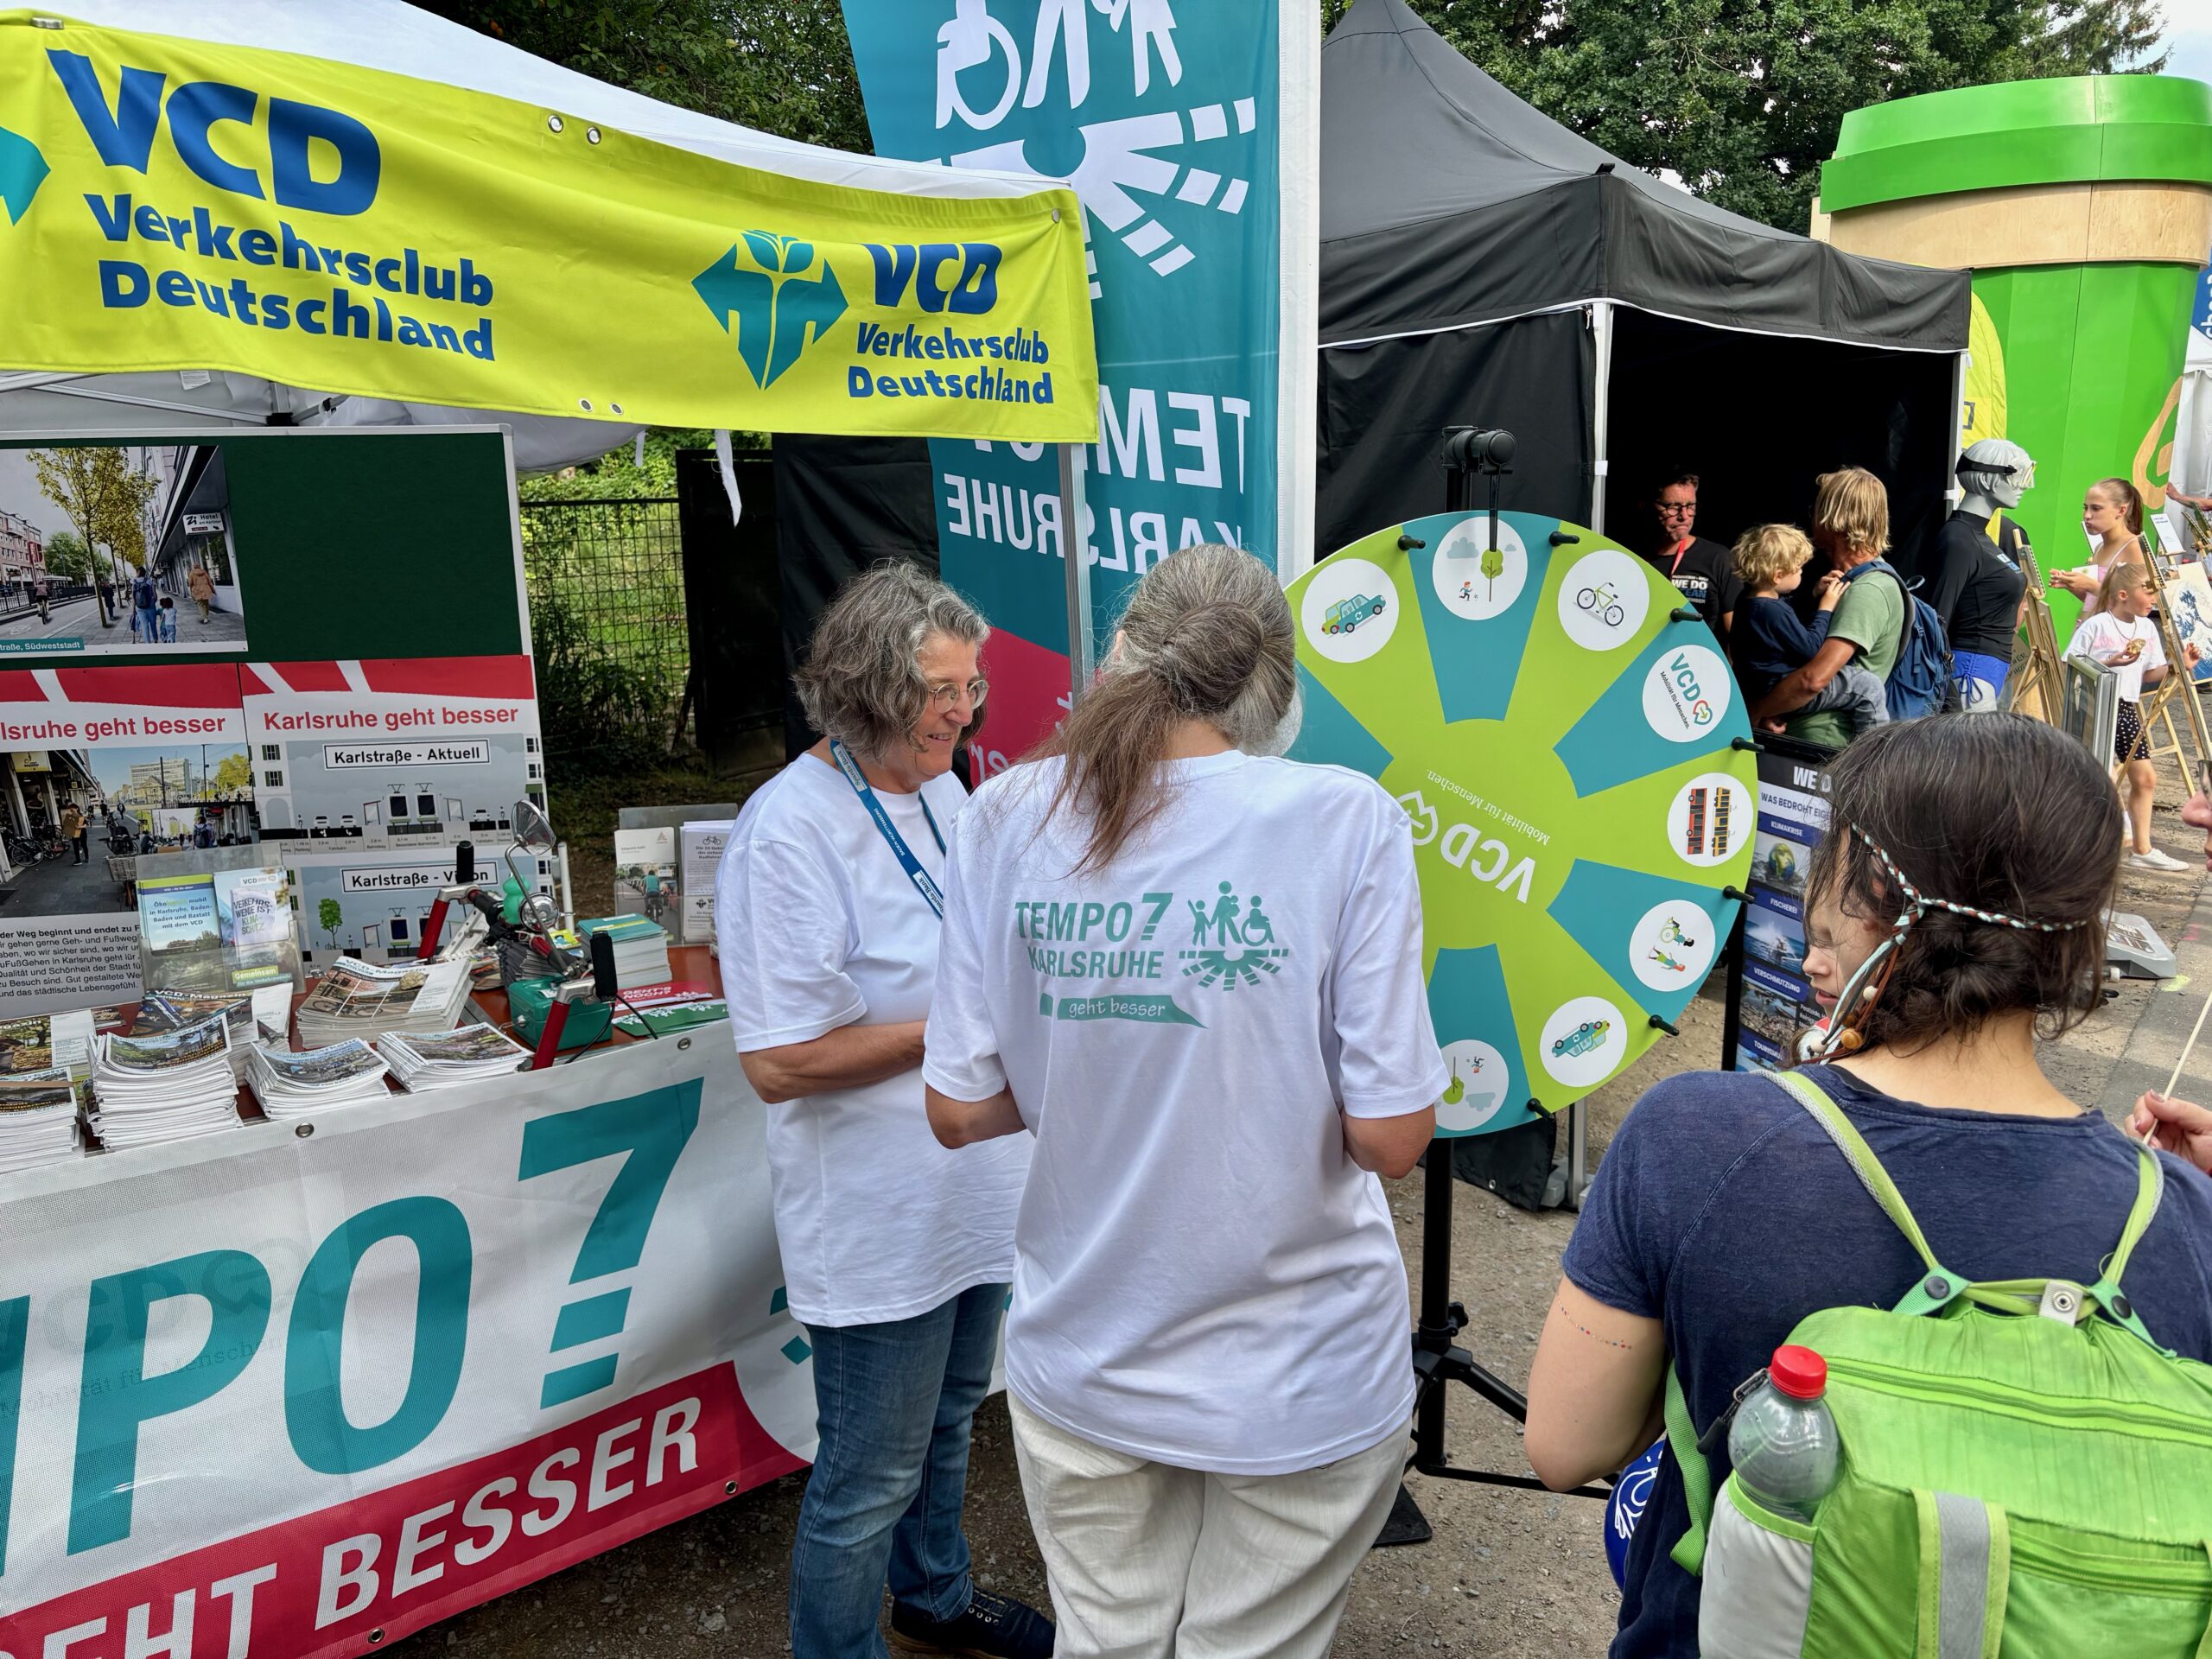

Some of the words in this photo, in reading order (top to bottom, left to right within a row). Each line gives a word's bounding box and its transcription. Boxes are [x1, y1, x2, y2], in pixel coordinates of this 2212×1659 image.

[45, 48, 381, 216] VCD
[83, 193, 493, 306] Verkehrsclub
[860, 243, 1003, 315] VCD
[99, 260, 495, 361] Deutschland
[856, 322, 1049, 365] Verkehrsclub
[848, 366, 1054, 404] Deutschland
[1672, 579, 1688, 588] WE
[1690, 580, 1708, 589] DO
[25, 641, 80, 651] Südweststadt
[1670, 652, 1700, 702] VCD
[1660, 671, 1674, 694] Mobilität
[1675, 702, 1689, 729] Menschen.
[0, 720, 77, 741] lsruhe
[85, 718, 136, 741] geht
[143, 717, 226, 734] besser
[264, 709, 378, 731] Karlsruhe
[385, 709, 435, 732] geht
[443, 706, 518, 725] besser
[334, 748, 412, 766] Karlstraße
[427, 747, 480, 762] Aktuell
[837, 750, 861, 787] Sparda-Bank
[1427, 769, 1484, 809] Menschen.
[1793, 766, 1818, 790] WE
[1484, 803, 1502, 819] für
[1761, 792, 1777, 804] WAS
[1778, 798, 1813, 815] BEDROHT
[1502, 814, 1550, 846] Mobilität
[1770, 820, 1803, 836] KLIMAKRISE
[1440, 823, 1535, 904] VCD
[352, 873, 429, 888] Karlstraße
[443, 870, 488, 882] Vion
[233, 897, 273, 909] VERKEHRS-
[1770, 897, 1797, 914] FISCHEREI
[39, 929, 72, 938] beginnt
[1014, 901, 1133, 942] TEMPO
[53, 947, 78, 956] sicher
[62, 956, 102, 964] Karlsruhe
[1027, 946, 1164, 979] KARLSRUHE
[10, 978, 41, 987] Besuch
[84, 974, 124, 983] gestaltete
[48, 966, 91, 975] Schönheit
[234, 968, 276, 980] Gemeinsam
[1754, 967, 1801, 994] VERSCHMUTZUNG
[35, 986, 77, 995] städtische
[79, 982, 138, 992] Lebensgefühl.
[1069, 1000, 1106, 1017] geht
[1110, 997, 1166, 1017] besser
[315, 1396, 702, 1630] BESSER
